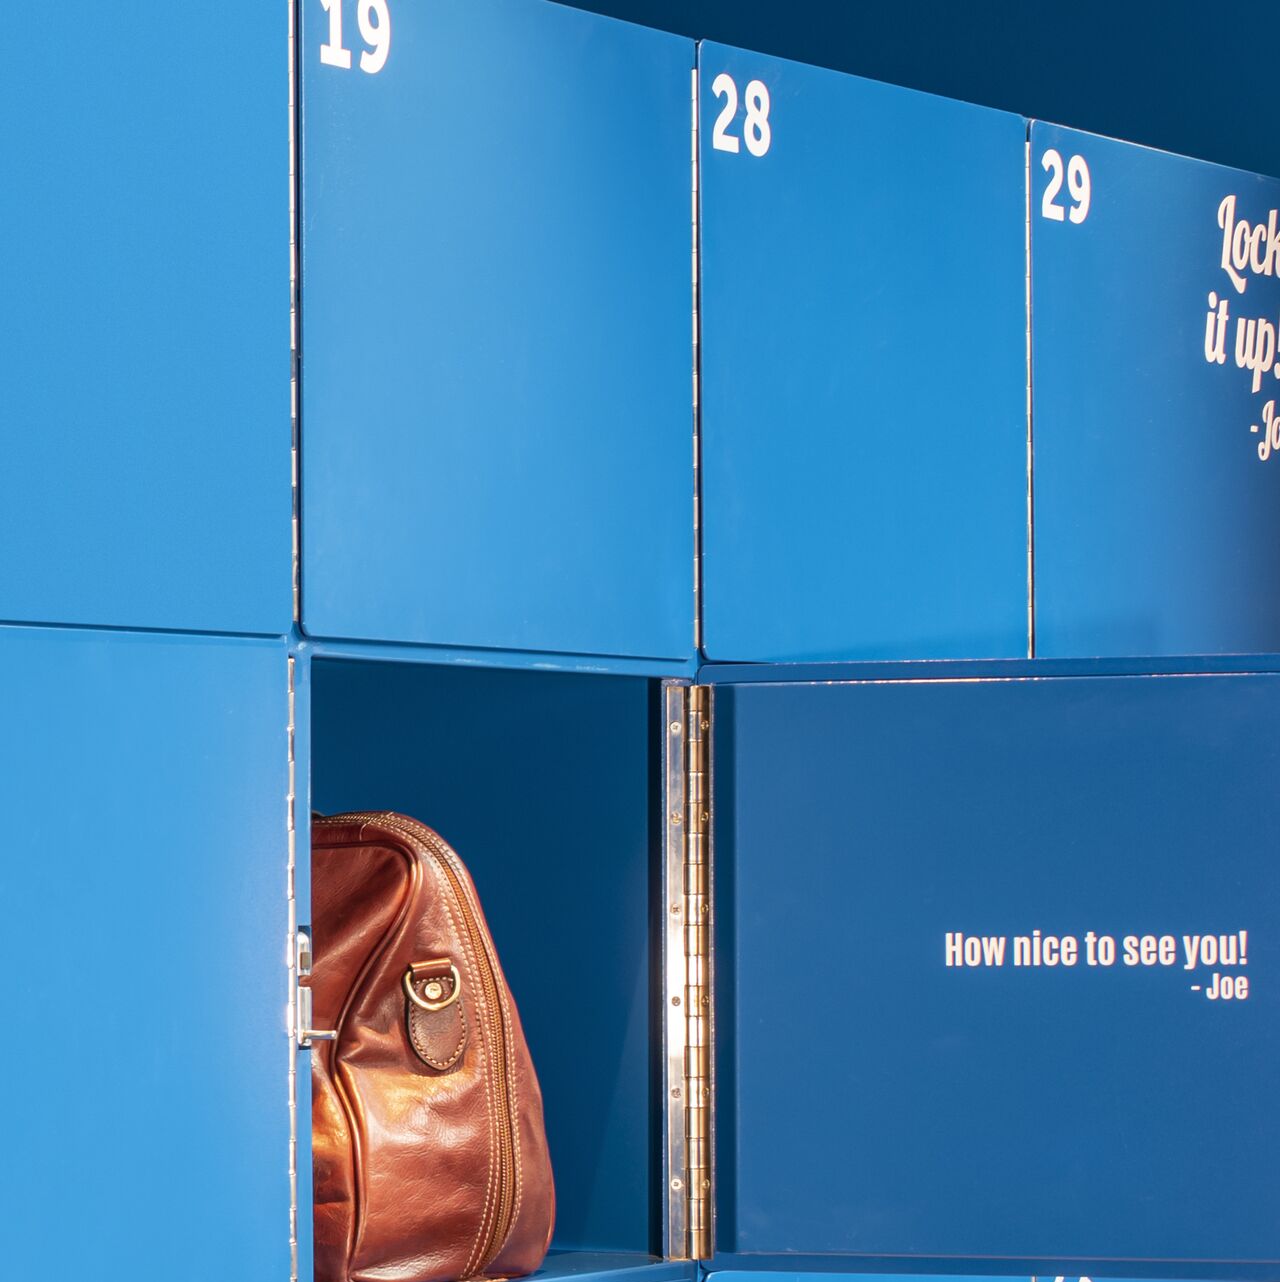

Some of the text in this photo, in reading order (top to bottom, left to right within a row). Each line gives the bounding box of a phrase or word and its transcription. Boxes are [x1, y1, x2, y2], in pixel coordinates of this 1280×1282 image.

[320, 0, 393, 75] 19
[712, 73, 772, 158] 28
[1042, 148, 1092, 225] 29
[1204, 291, 1230, 365] it
[944, 929, 1248, 971] How nice to see you!
